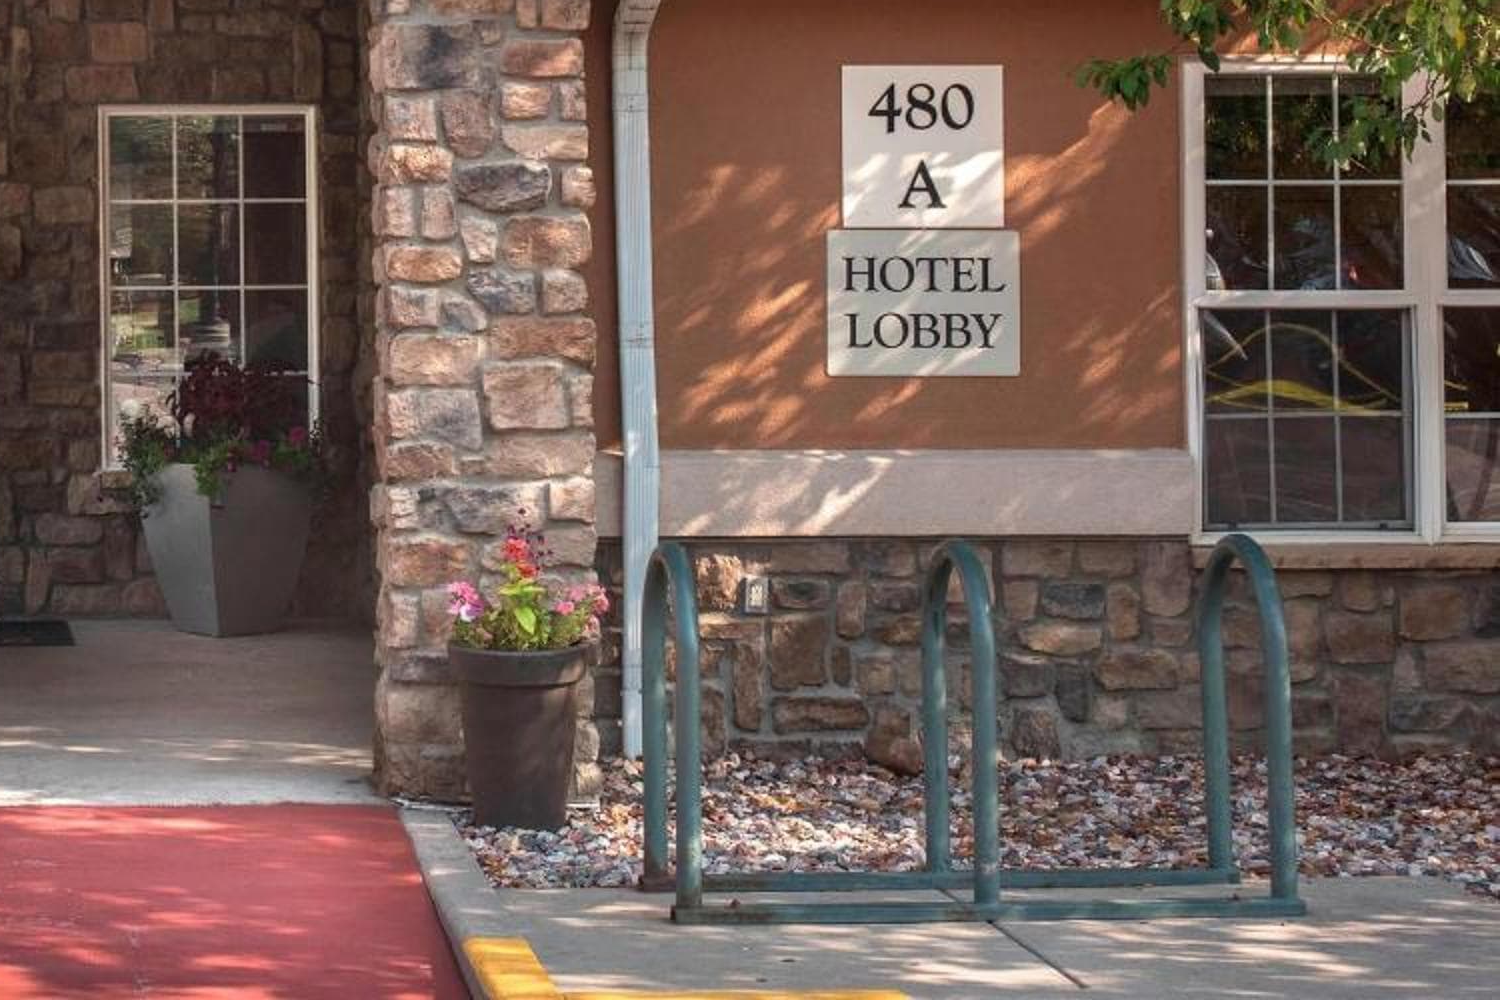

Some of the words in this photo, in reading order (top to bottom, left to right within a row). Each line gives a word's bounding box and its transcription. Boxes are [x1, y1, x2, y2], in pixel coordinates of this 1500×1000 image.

[867, 82, 975, 134] 480
[897, 159, 947, 209] A
[841, 255, 1006, 293] HOTEL
[845, 312, 1003, 349] LOBBY
